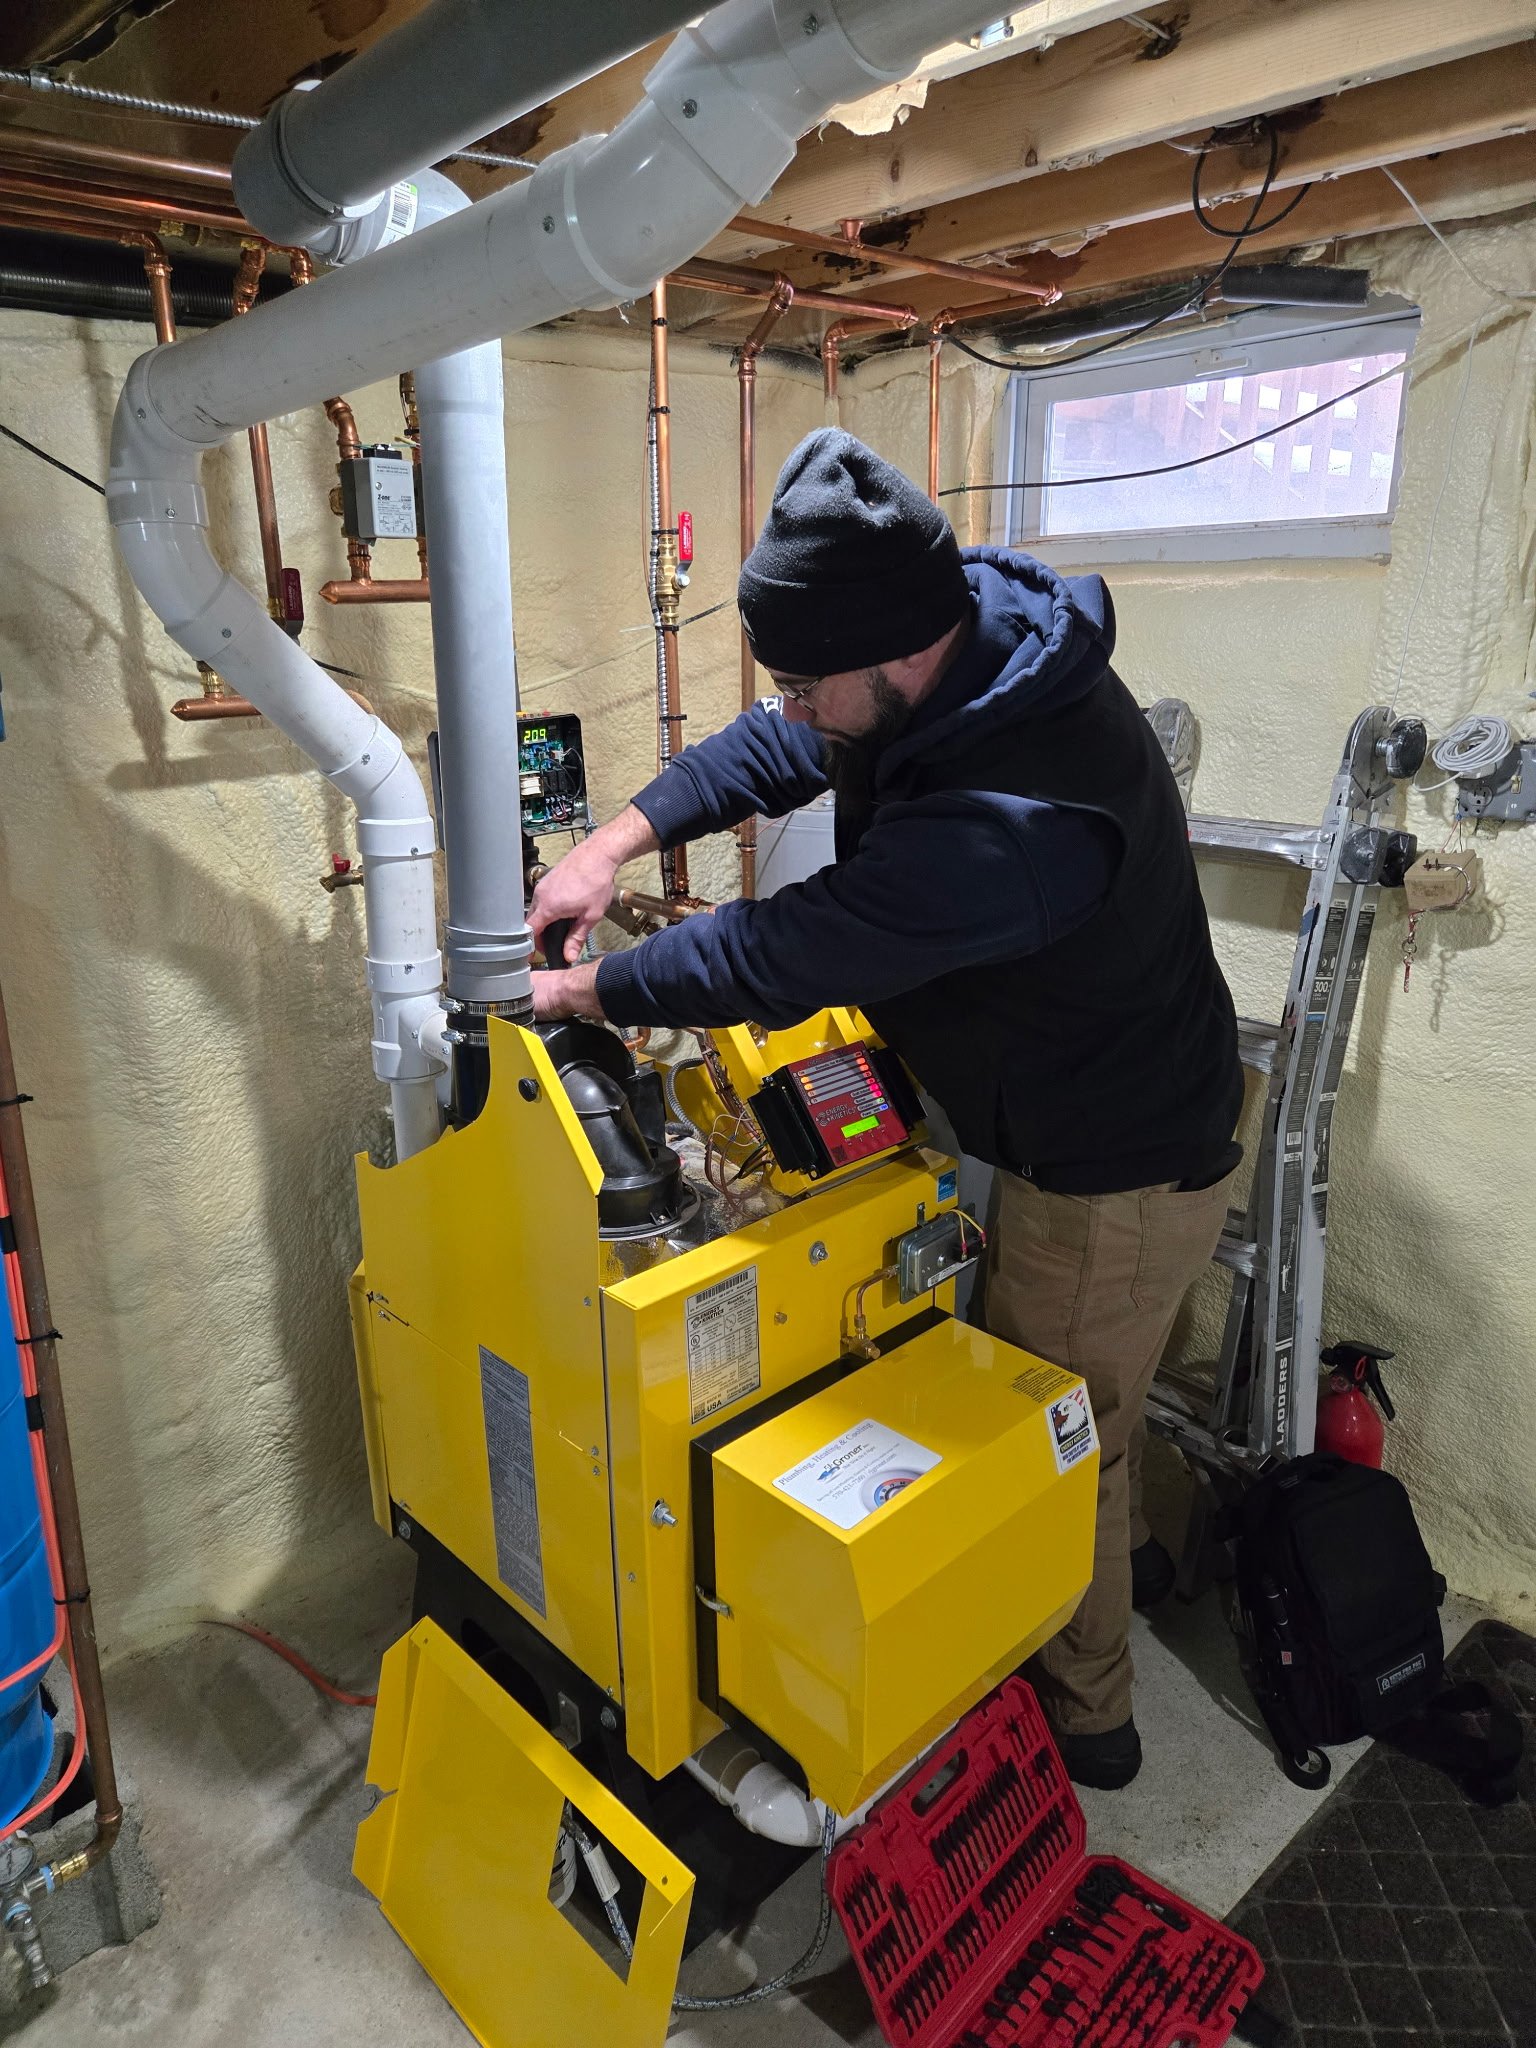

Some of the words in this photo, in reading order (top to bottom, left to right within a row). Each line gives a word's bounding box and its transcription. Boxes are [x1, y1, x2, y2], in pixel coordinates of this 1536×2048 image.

[524, 728, 546, 744] 209
[1314, 980, 1328, 992] 300
[826, 1104, 848, 1115] ENERGY
[829, 1107, 855, 1120] KINETICS
[700, 1306, 720, 1319] ENERGY
[703, 1308, 724, 1322] KINETICS
[707, 1400, 722, 1412] USA
[1276, 1356, 1288, 1446] LADDERS
[778, 1462, 816, 1485] Plumbing,
[813, 1444, 841, 1463] Heating
[846, 1423, 873, 1440] Cooling
[833, 1444, 863, 1467] Groner
